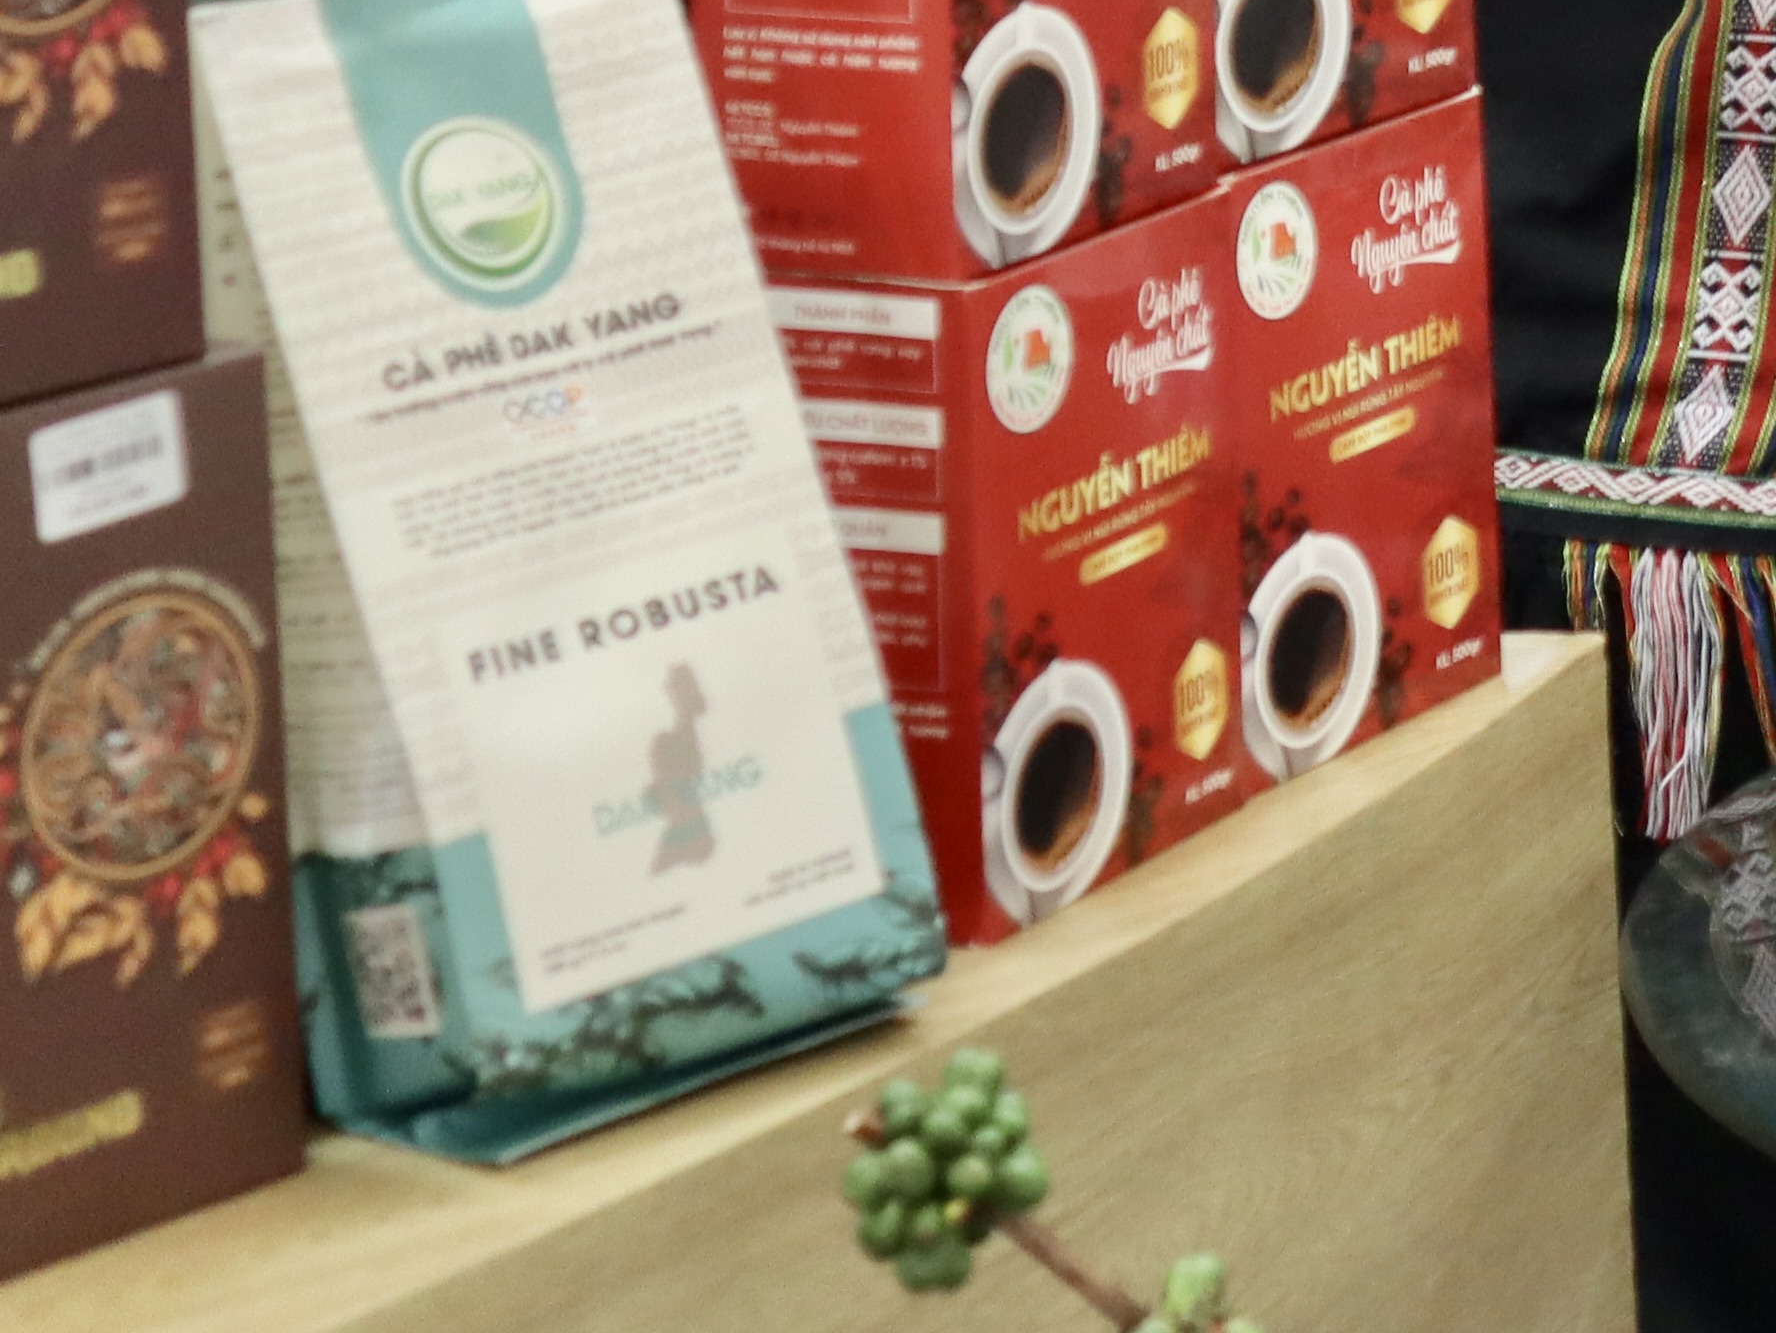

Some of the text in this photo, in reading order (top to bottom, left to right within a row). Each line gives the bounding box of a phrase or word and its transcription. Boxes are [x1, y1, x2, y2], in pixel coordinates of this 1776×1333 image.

[1149, 39, 1190, 79] 100%
[1379, 165, 1446, 230] Cà phê
[1350, 228, 1422, 295] Nguyên
[1137, 267, 1203, 336] Cà phê
[382, 345, 435, 391] CÀ
[582, 291, 681, 337] YANG
[1428, 544, 1470, 588] 100%
[466, 565, 780, 683] FINE ROBUSTA
